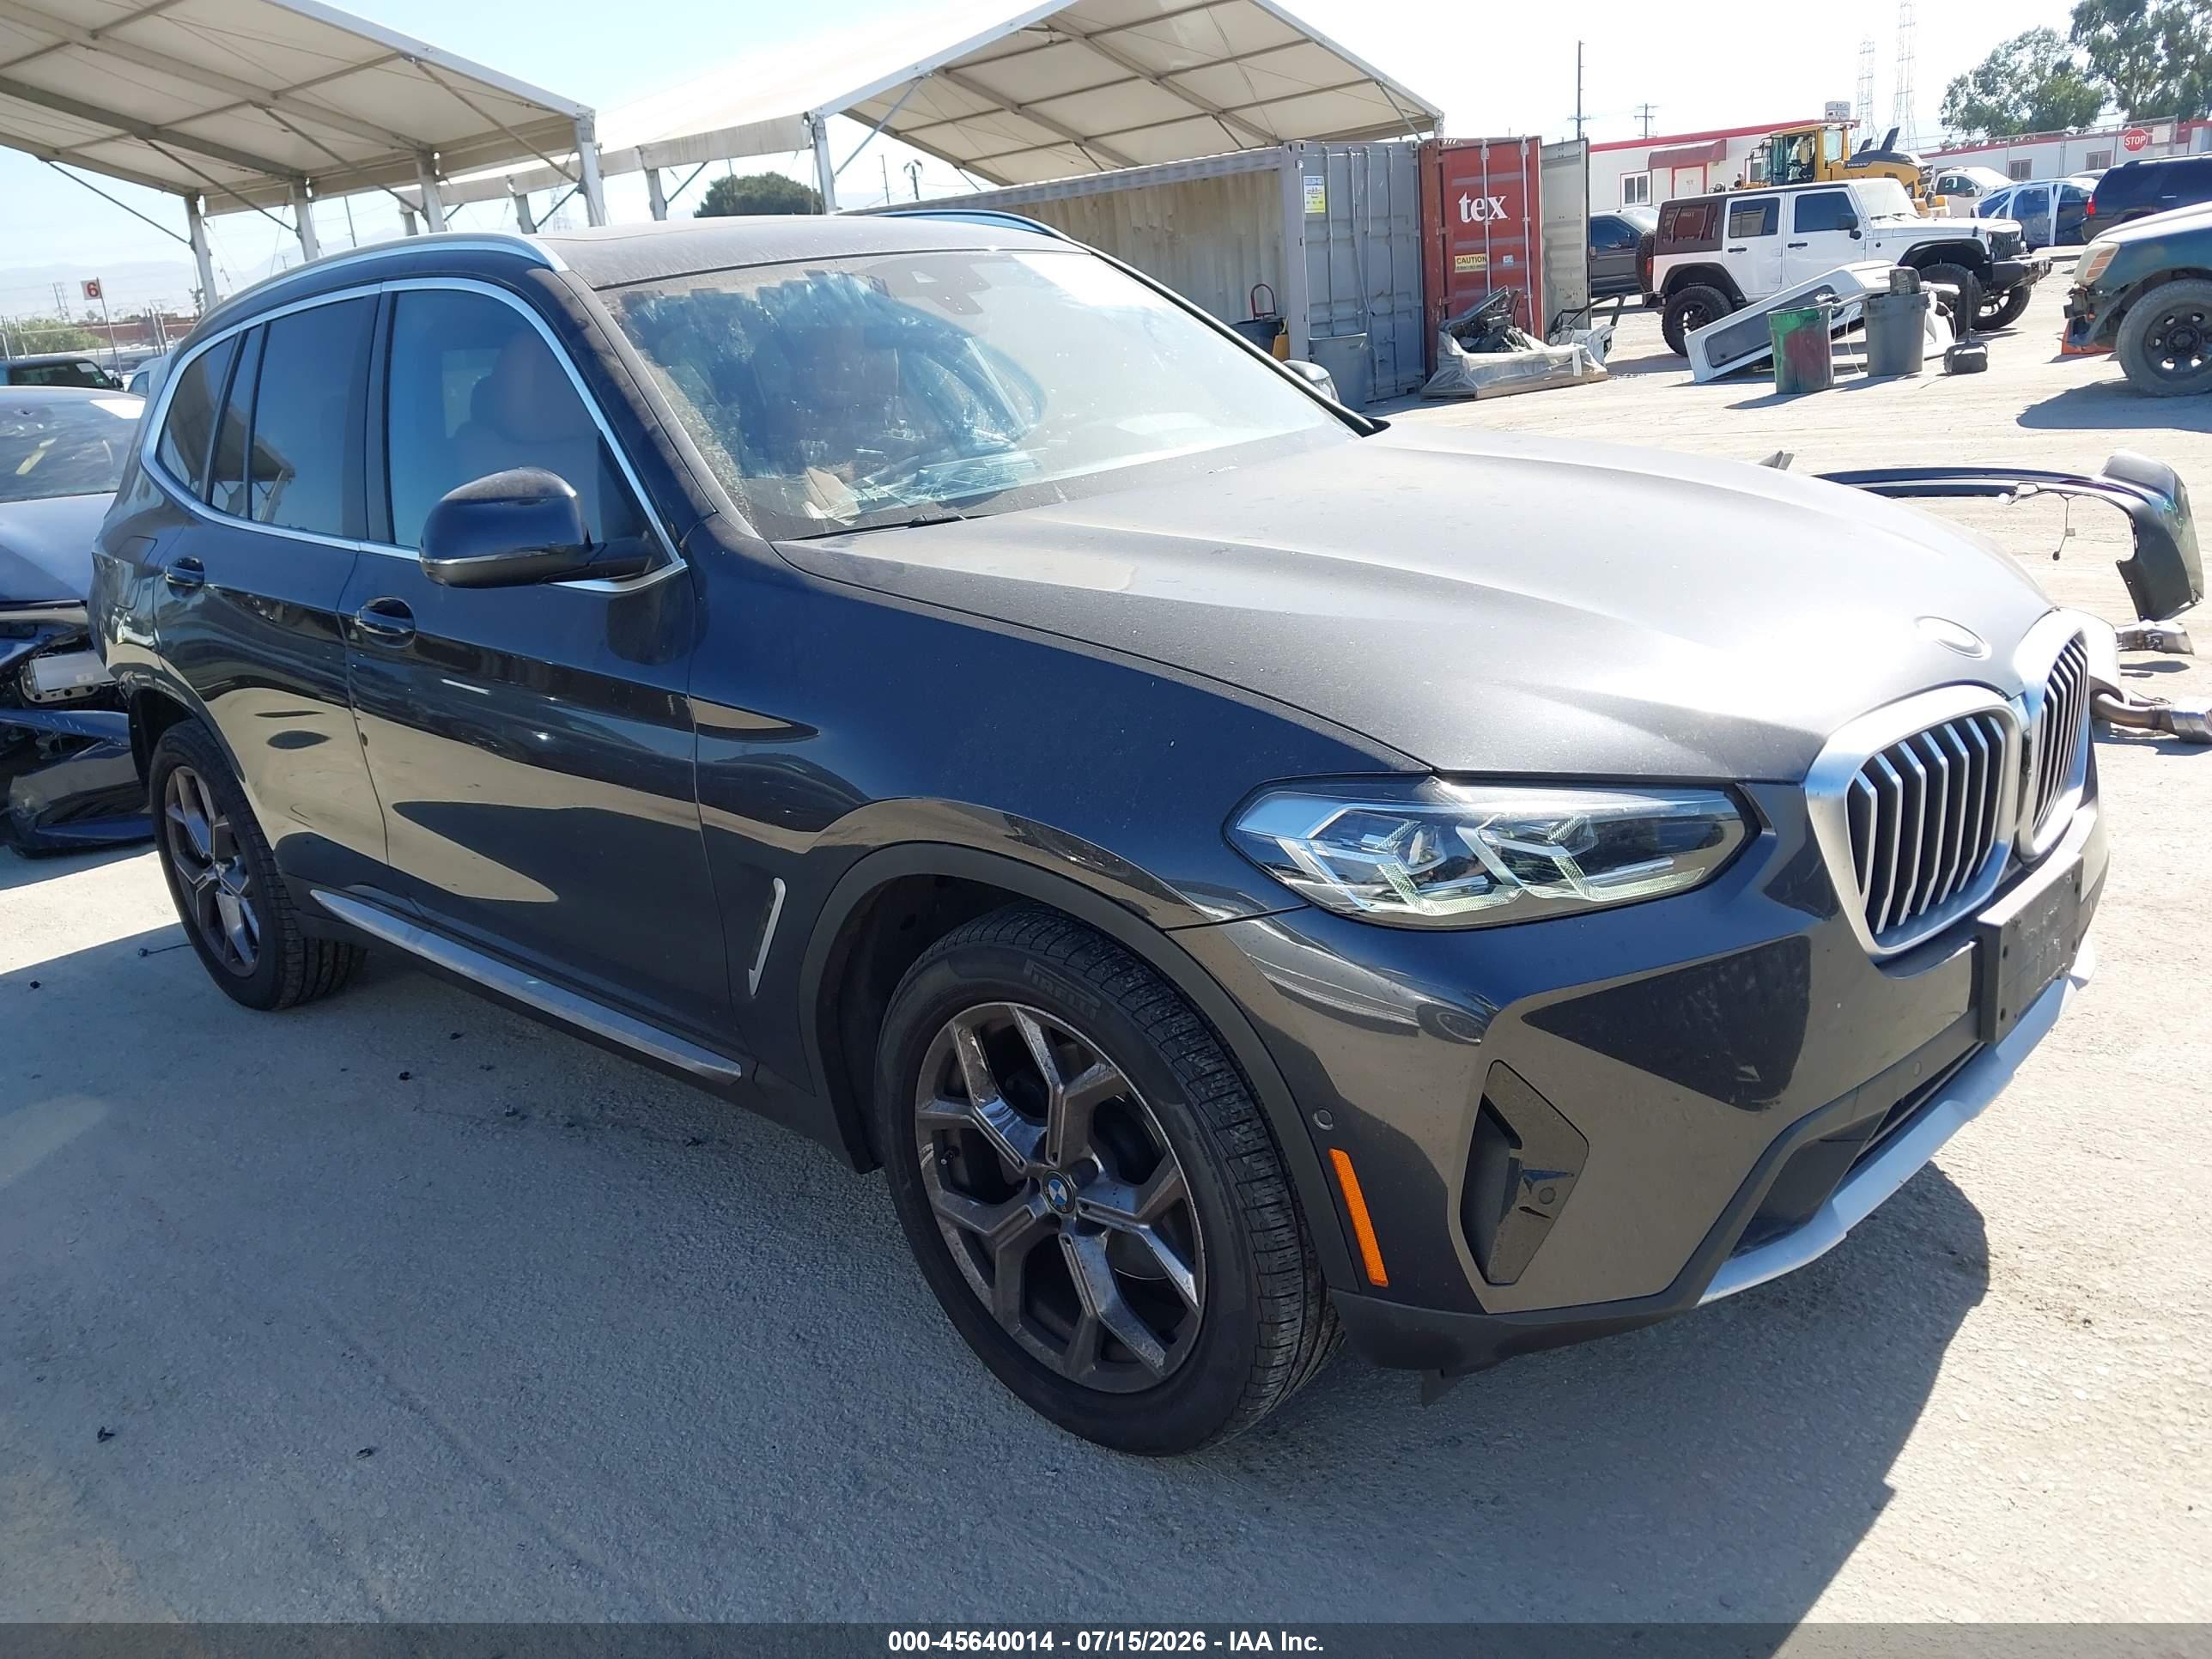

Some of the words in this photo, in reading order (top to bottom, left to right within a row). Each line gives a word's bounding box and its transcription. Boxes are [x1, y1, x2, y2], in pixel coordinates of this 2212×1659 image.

[2125, 136, 2146, 146] STOP
[1456, 256, 1487, 264] CAUTION
[87, 282, 99, 297] 6
